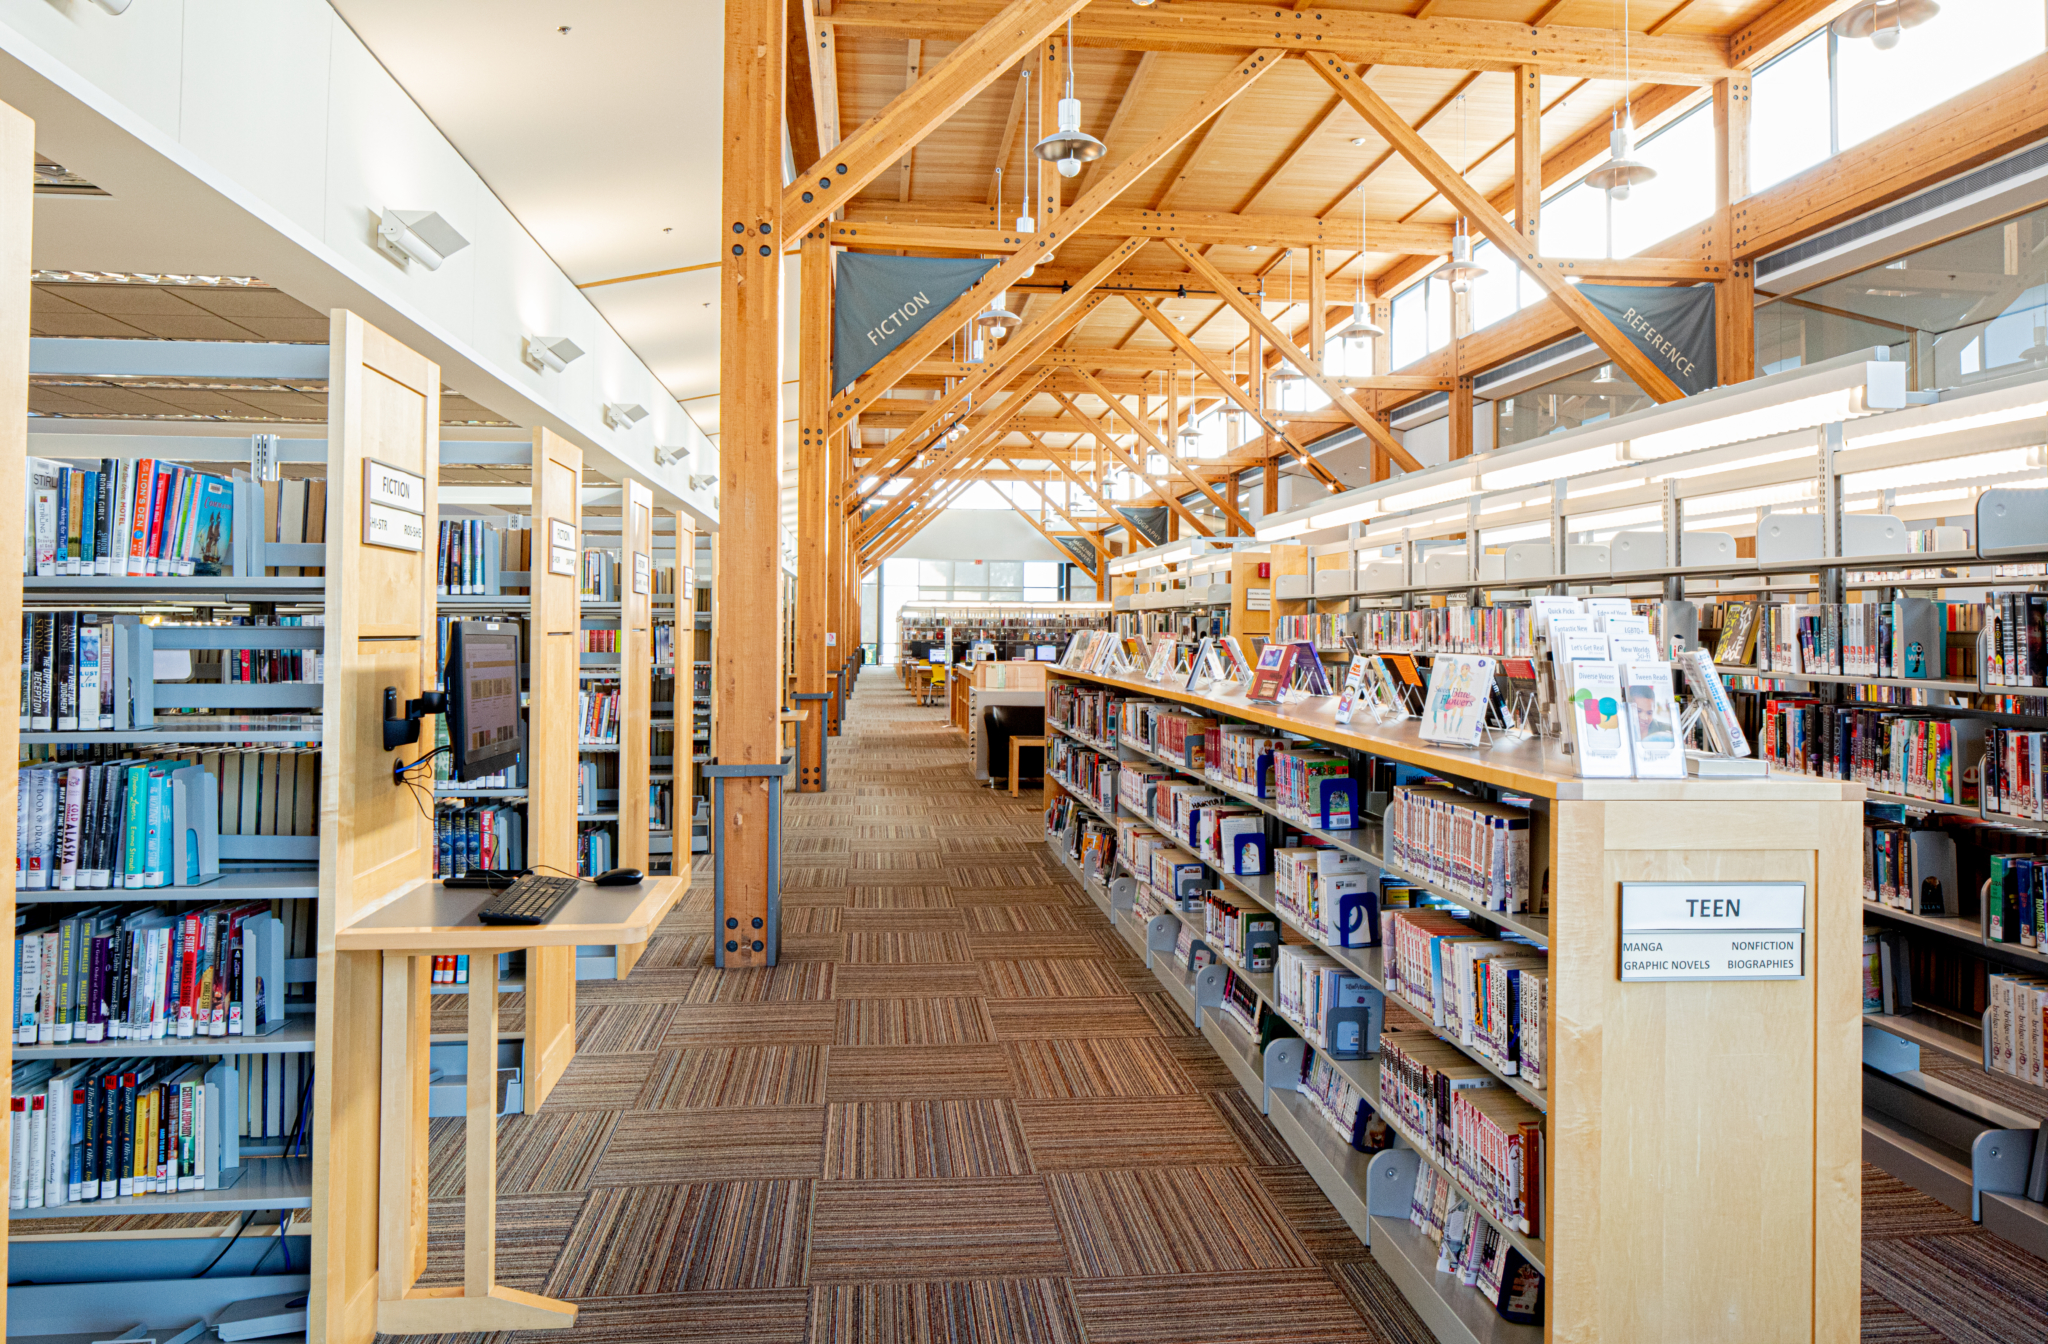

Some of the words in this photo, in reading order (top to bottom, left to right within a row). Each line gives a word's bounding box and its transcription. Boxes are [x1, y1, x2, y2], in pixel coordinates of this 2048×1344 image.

[866, 291, 931, 346] FICTION
[1622, 307, 1695, 377] REFERENCE
[138, 473, 148, 504] LION'S
[383, 476, 410, 499] FICTION
[136, 507, 145, 527] DEN
[1133, 514, 1162, 541] BIOGRAPHY
[1068, 542, 1092, 564] NEWSPAPERS
[1073, 539, 1094, 559] MAGAZINES
[35, 618, 44, 651] STONE
[44, 619, 53, 652] DAVID
[2017, 626, 2026, 644] LAST
[33, 671, 42, 714] DECEPTION
[42, 668, 51, 703] ORPHEUS
[1452, 688, 1470, 698] Blue
[60, 682, 68, 714] JUDGMENT
[1441, 695, 1473, 706] Flowers
[36, 790, 44, 812] BOOK
[70, 803, 79, 822] COLD
[482, 814, 491, 826] Map
[63, 823, 76, 865] ALASKA
[1686, 898, 1740, 918] TEEN
[2036, 898, 2044, 932] ROOMIES
[186, 919, 196, 935] DARK
[208, 915, 217, 932] EMPIRE
[114, 926, 122, 952] Northern
[184, 936, 195, 953] STATE
[1623, 942, 1663, 952] MANGA
[1732, 941, 1794, 950] NONFICTION
[81, 947, 89, 974] NAMELESS
[1624, 960, 1668, 970] GRAPHIC
[1672, 960, 1710, 970] NOVELS
[1728, 959, 1794, 969] BIOGRAPHIES
[182, 960, 193, 985] CHARLES
[181, 987, 191, 1007] STROSS
[202, 982, 210, 999] CHARLES
[182, 1086, 193, 1109] CERTAIN
[182, 1110, 192, 1138] JEOPARDY
